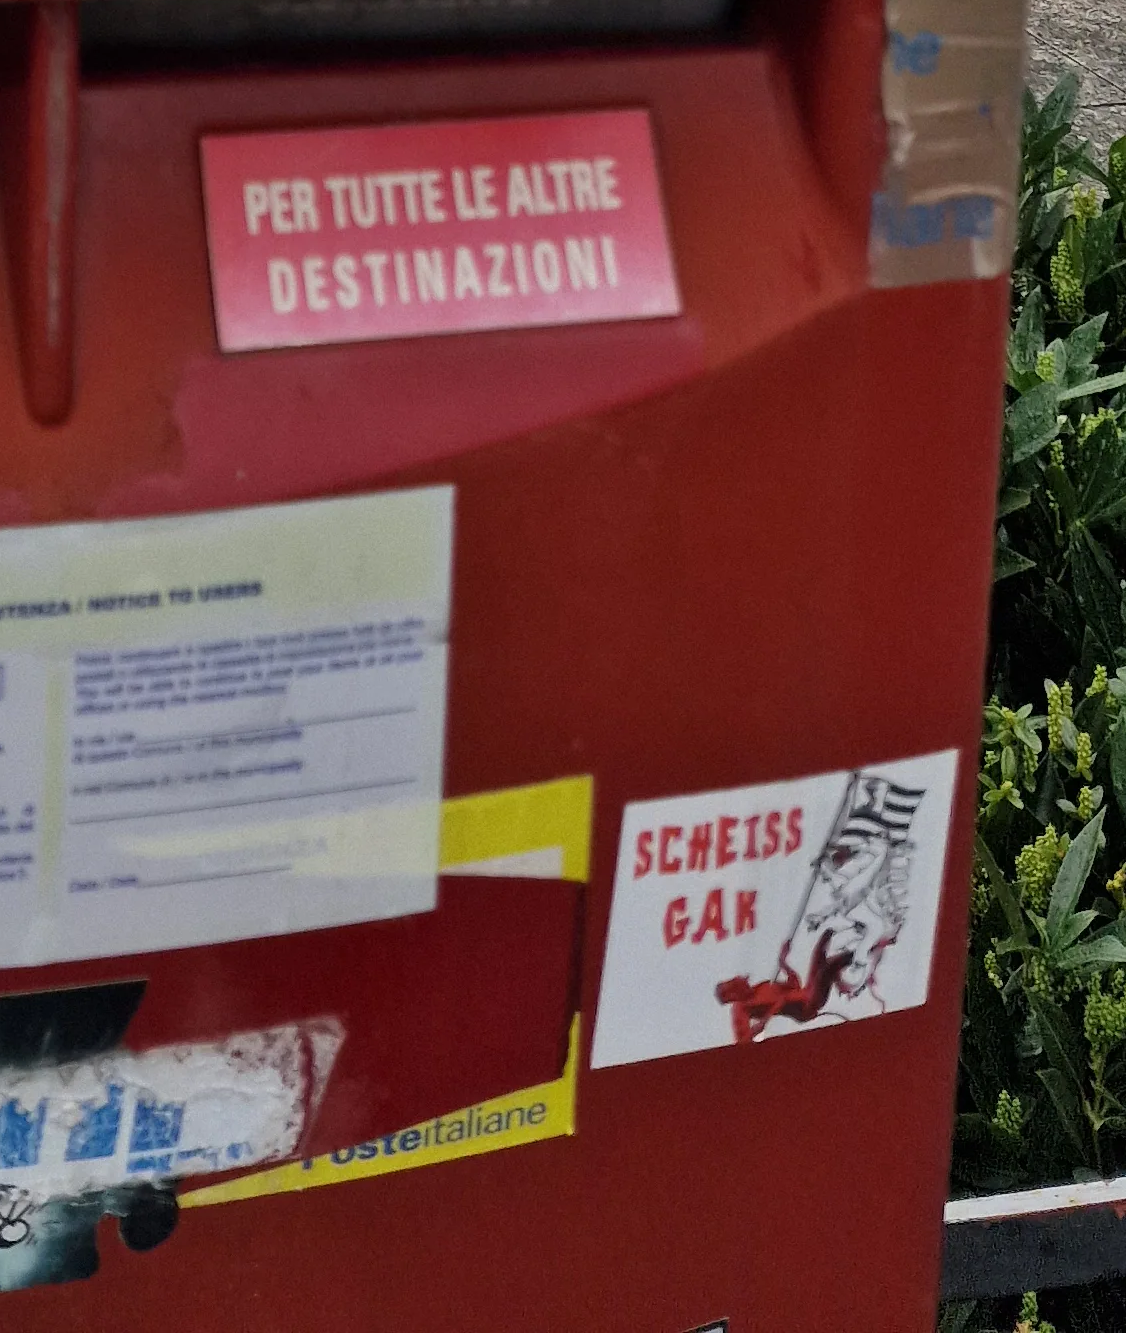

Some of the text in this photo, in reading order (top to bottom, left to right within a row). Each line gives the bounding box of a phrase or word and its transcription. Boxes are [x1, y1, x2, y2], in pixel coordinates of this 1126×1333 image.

[243, 156, 624, 235] PER TUTTE LE ALTRE
[267, 234, 620, 317] DESTINAZIONI
[87, 591, 161, 612] NOTICE
[168, 588, 194, 605] TO
[197, 580, 263, 603] USERS
[633, 806, 804, 881] SCHEISS
